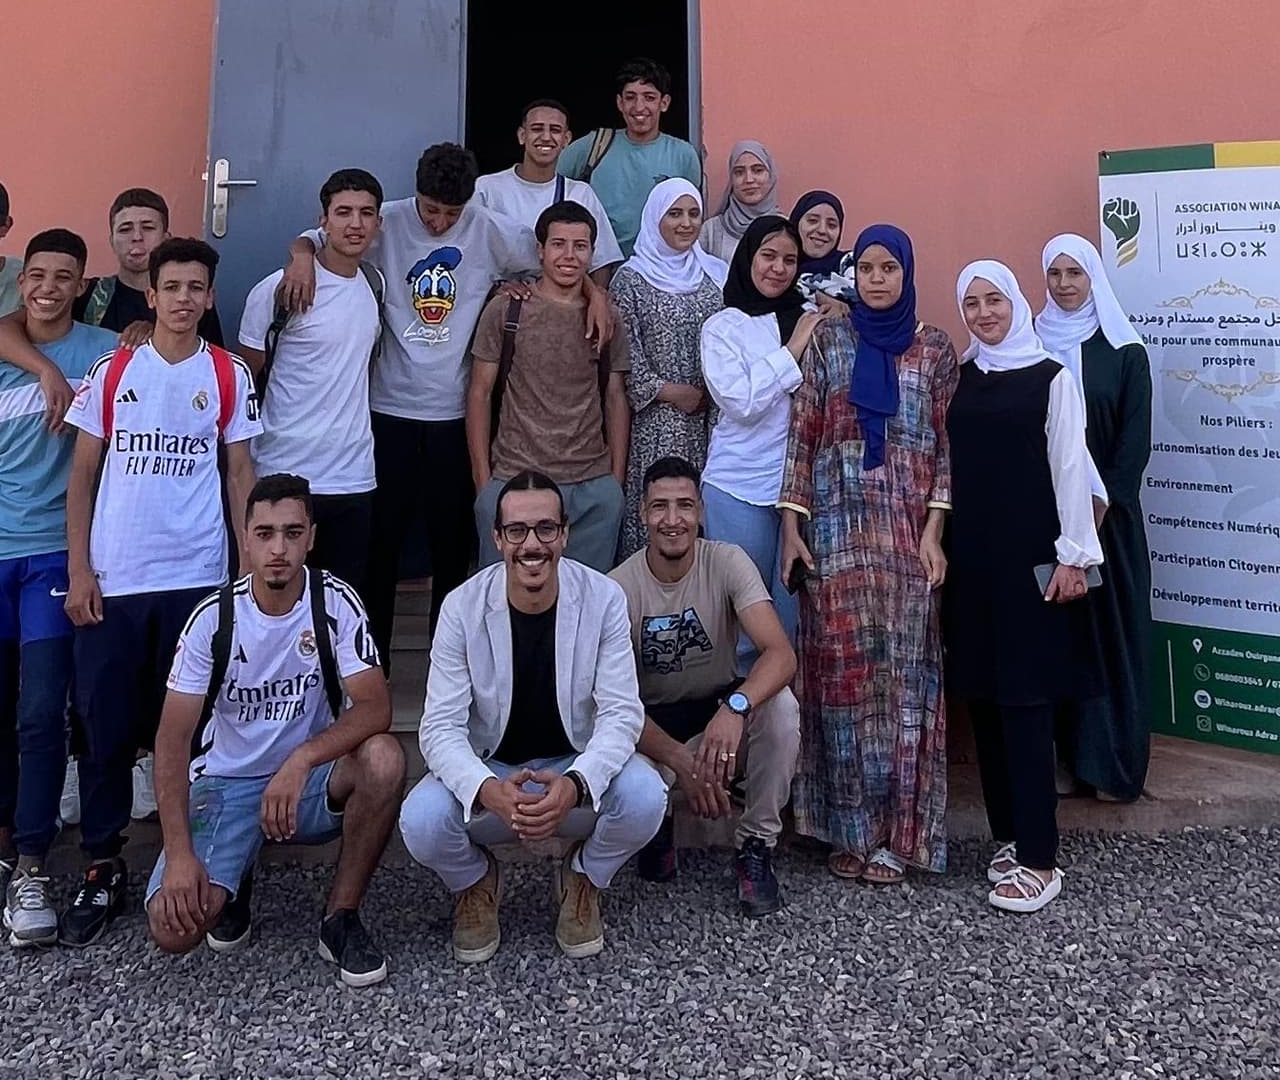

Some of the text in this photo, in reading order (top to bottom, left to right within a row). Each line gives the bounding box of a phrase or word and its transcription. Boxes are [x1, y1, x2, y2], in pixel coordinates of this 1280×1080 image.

[1175, 202, 1247, 213] ASSOCIATION
[1167, 312, 1215, 328] مستدام
[1218, 314, 1261, 329] مجتمع
[1161, 337, 1187, 347] pour
[1190, 338, 1211, 346] une
[1202, 354, 1256, 368] prospère
[1200, 415, 1223, 426] Nos
[1226, 416, 1266, 429] Piliers
[115, 427, 209, 455] Emirates
[1152, 443, 1235, 456] utonomisation
[1238, 445, 1259, 458] des
[125, 456, 149, 475] FLY
[1146, 477, 1234, 494] Environnement
[1148, 513, 1224, 531] Compétences
[1150, 551, 1226, 568] Participation
[1152, 588, 1242, 609] Développement
[238, 705, 261, 722] FLY
